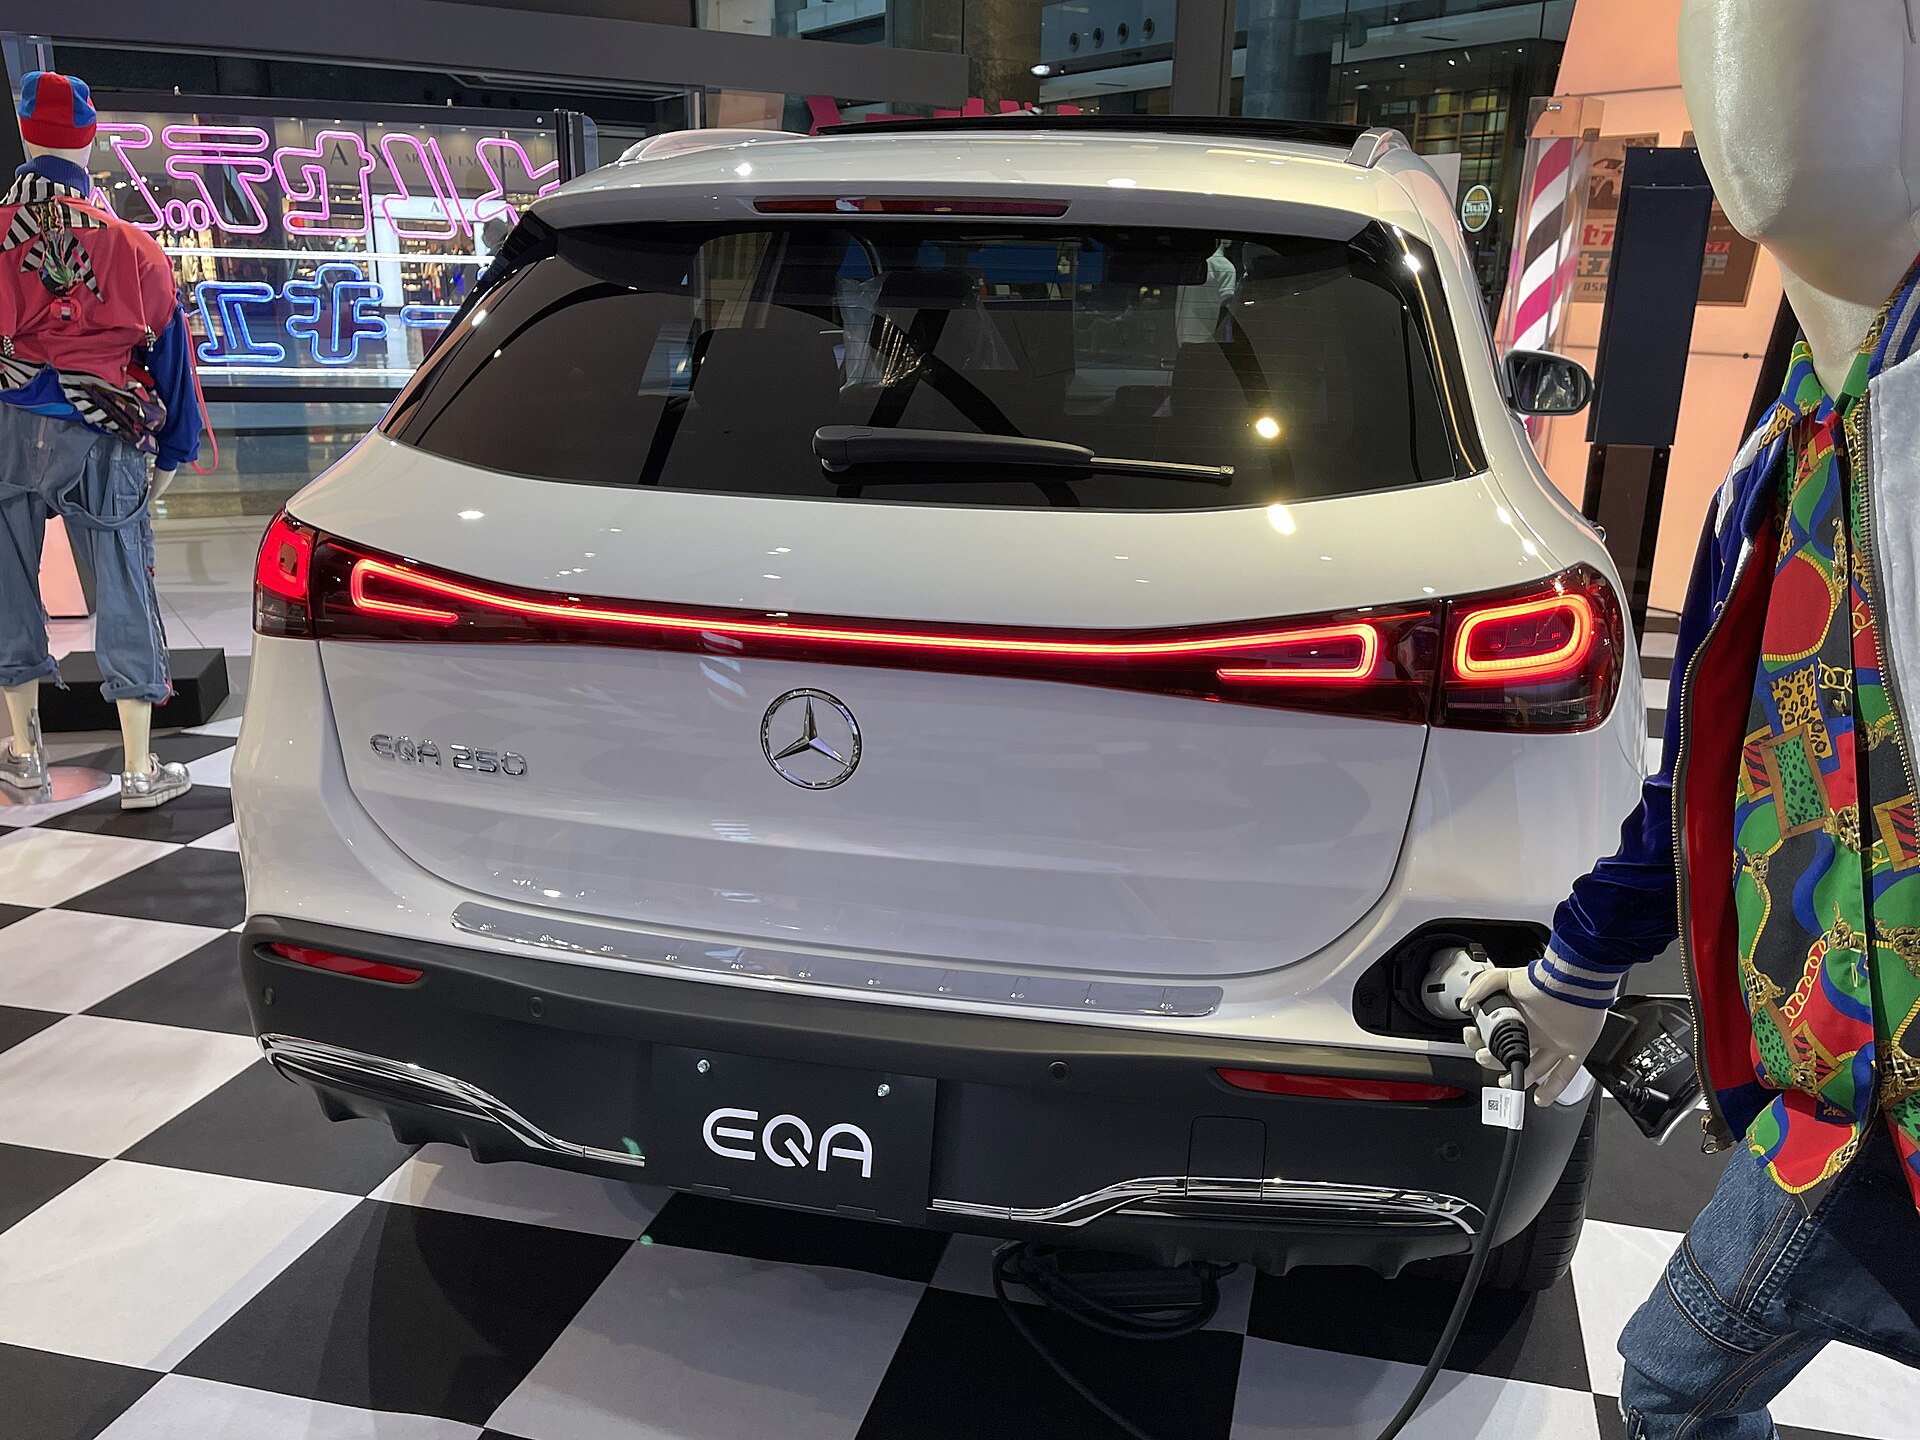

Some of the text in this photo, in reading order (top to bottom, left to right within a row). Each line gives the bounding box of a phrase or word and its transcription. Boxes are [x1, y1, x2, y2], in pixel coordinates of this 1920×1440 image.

[370, 733, 528, 776] EQA 250
[702, 1107, 873, 1179] EQA
